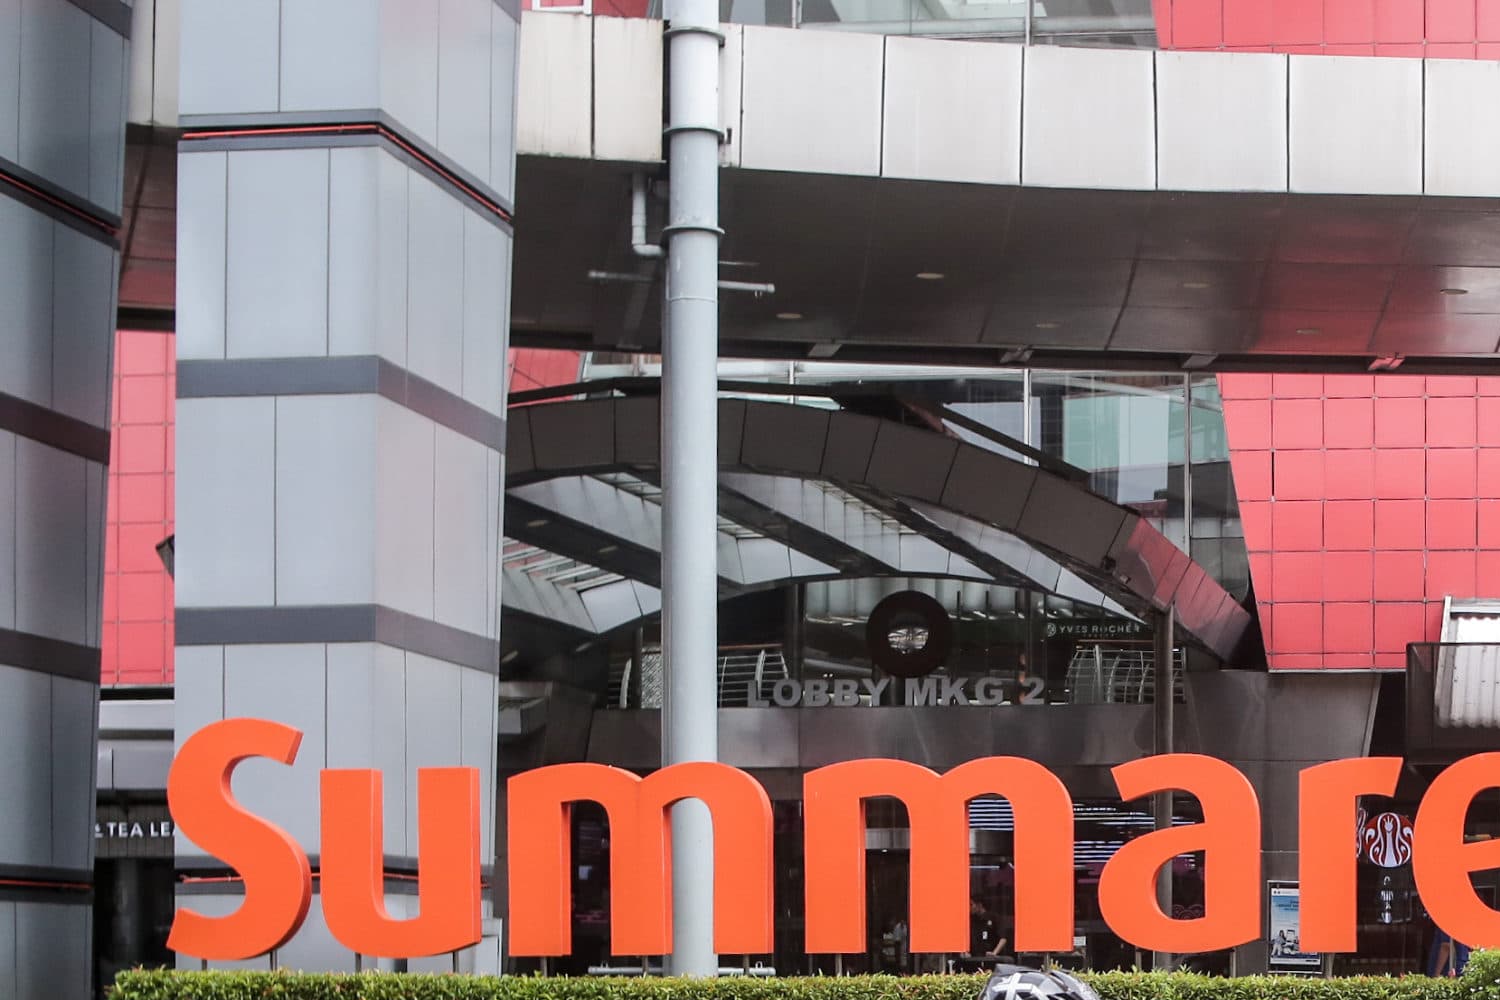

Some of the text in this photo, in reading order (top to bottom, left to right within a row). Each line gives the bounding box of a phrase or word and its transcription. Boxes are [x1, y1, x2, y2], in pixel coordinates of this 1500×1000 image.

[1060, 625, 1088, 633] YVES
[747, 677, 1045, 707] LOBBY MKG 2
[106, 822, 143, 838] TEA
